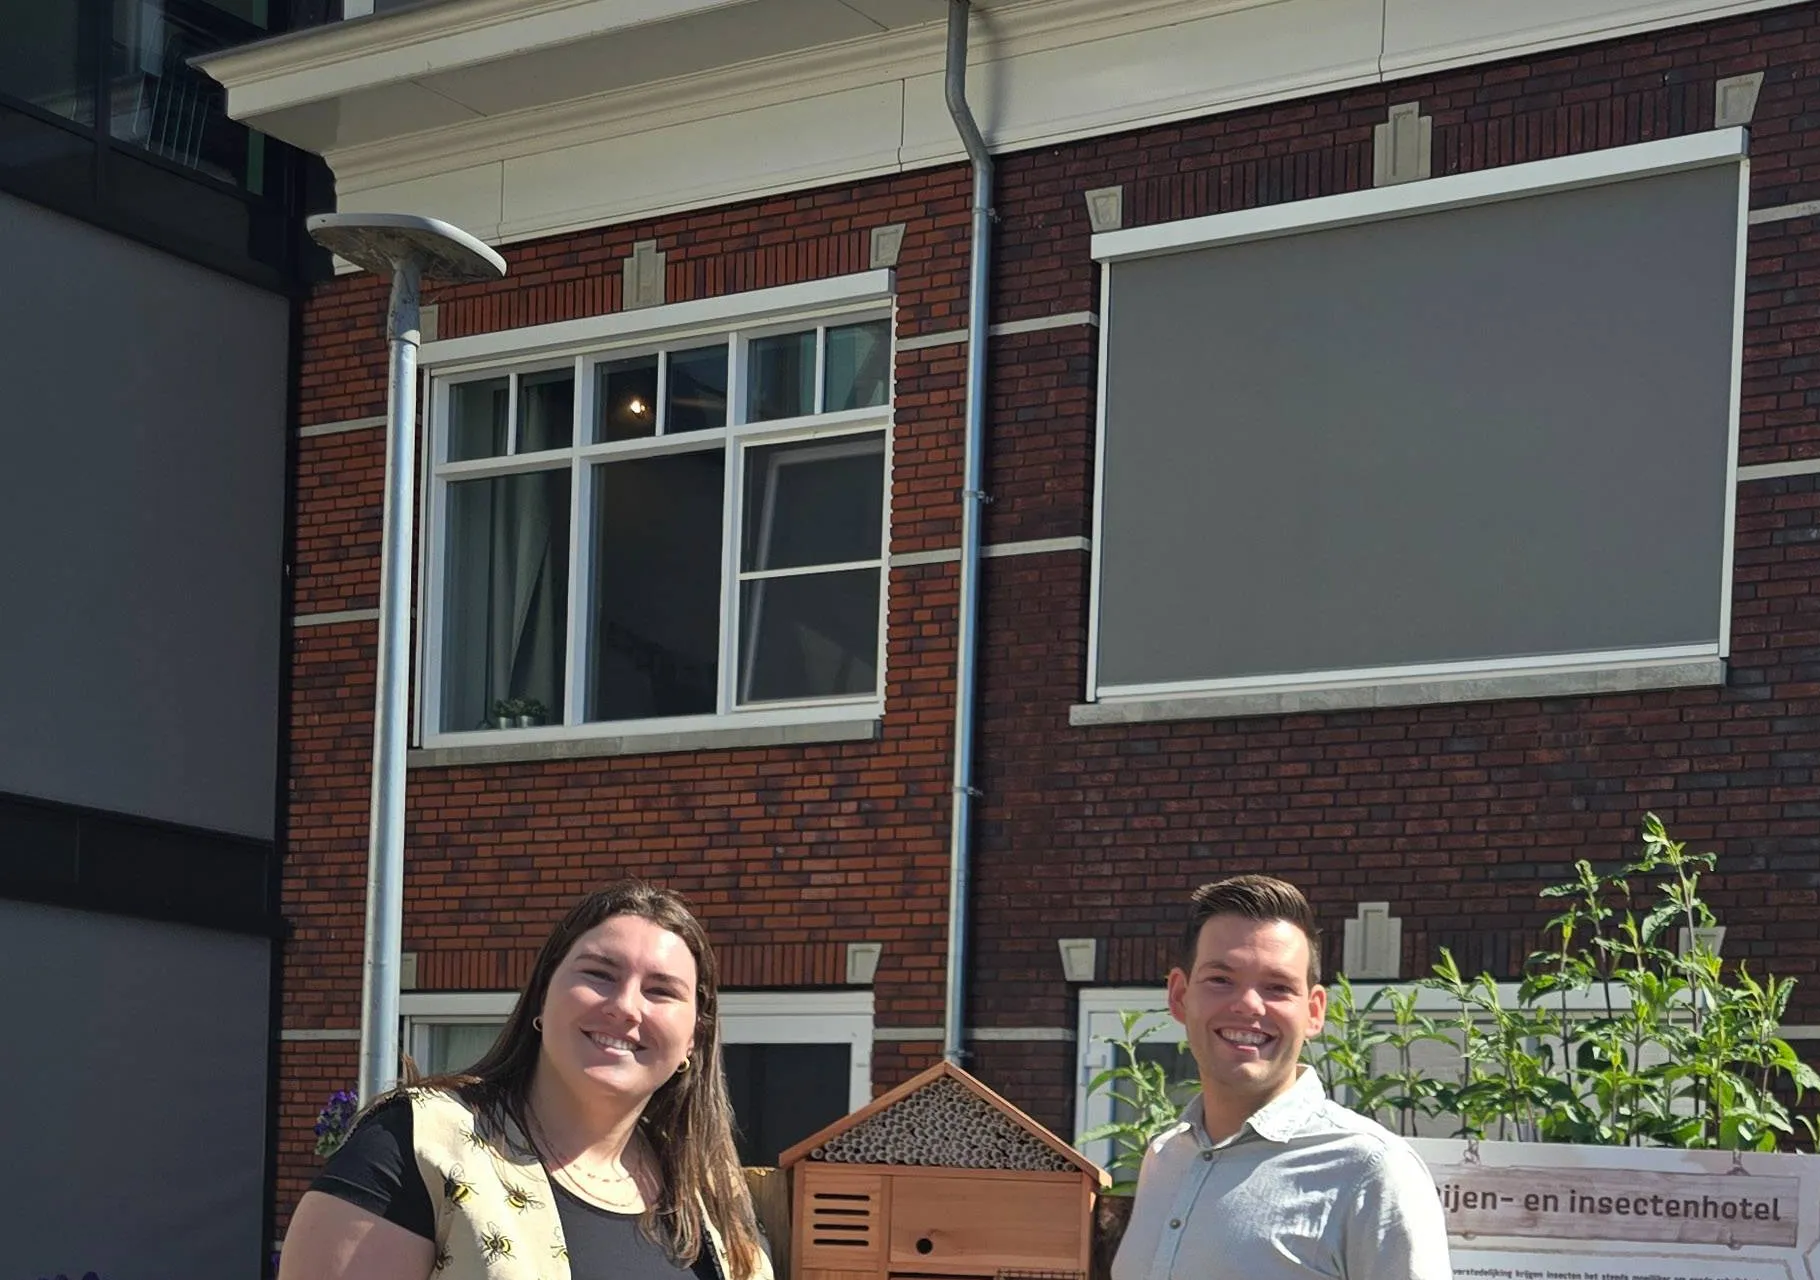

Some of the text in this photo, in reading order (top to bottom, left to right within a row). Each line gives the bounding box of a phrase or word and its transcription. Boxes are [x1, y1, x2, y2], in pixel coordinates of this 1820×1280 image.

[1524, 1192, 1558, 1212] en
[1570, 1190, 1781, 1222] insectenhotel
[1515, 1270, 1544, 1280] krijgen
[1546, 1271, 1582, 1280] insecten
